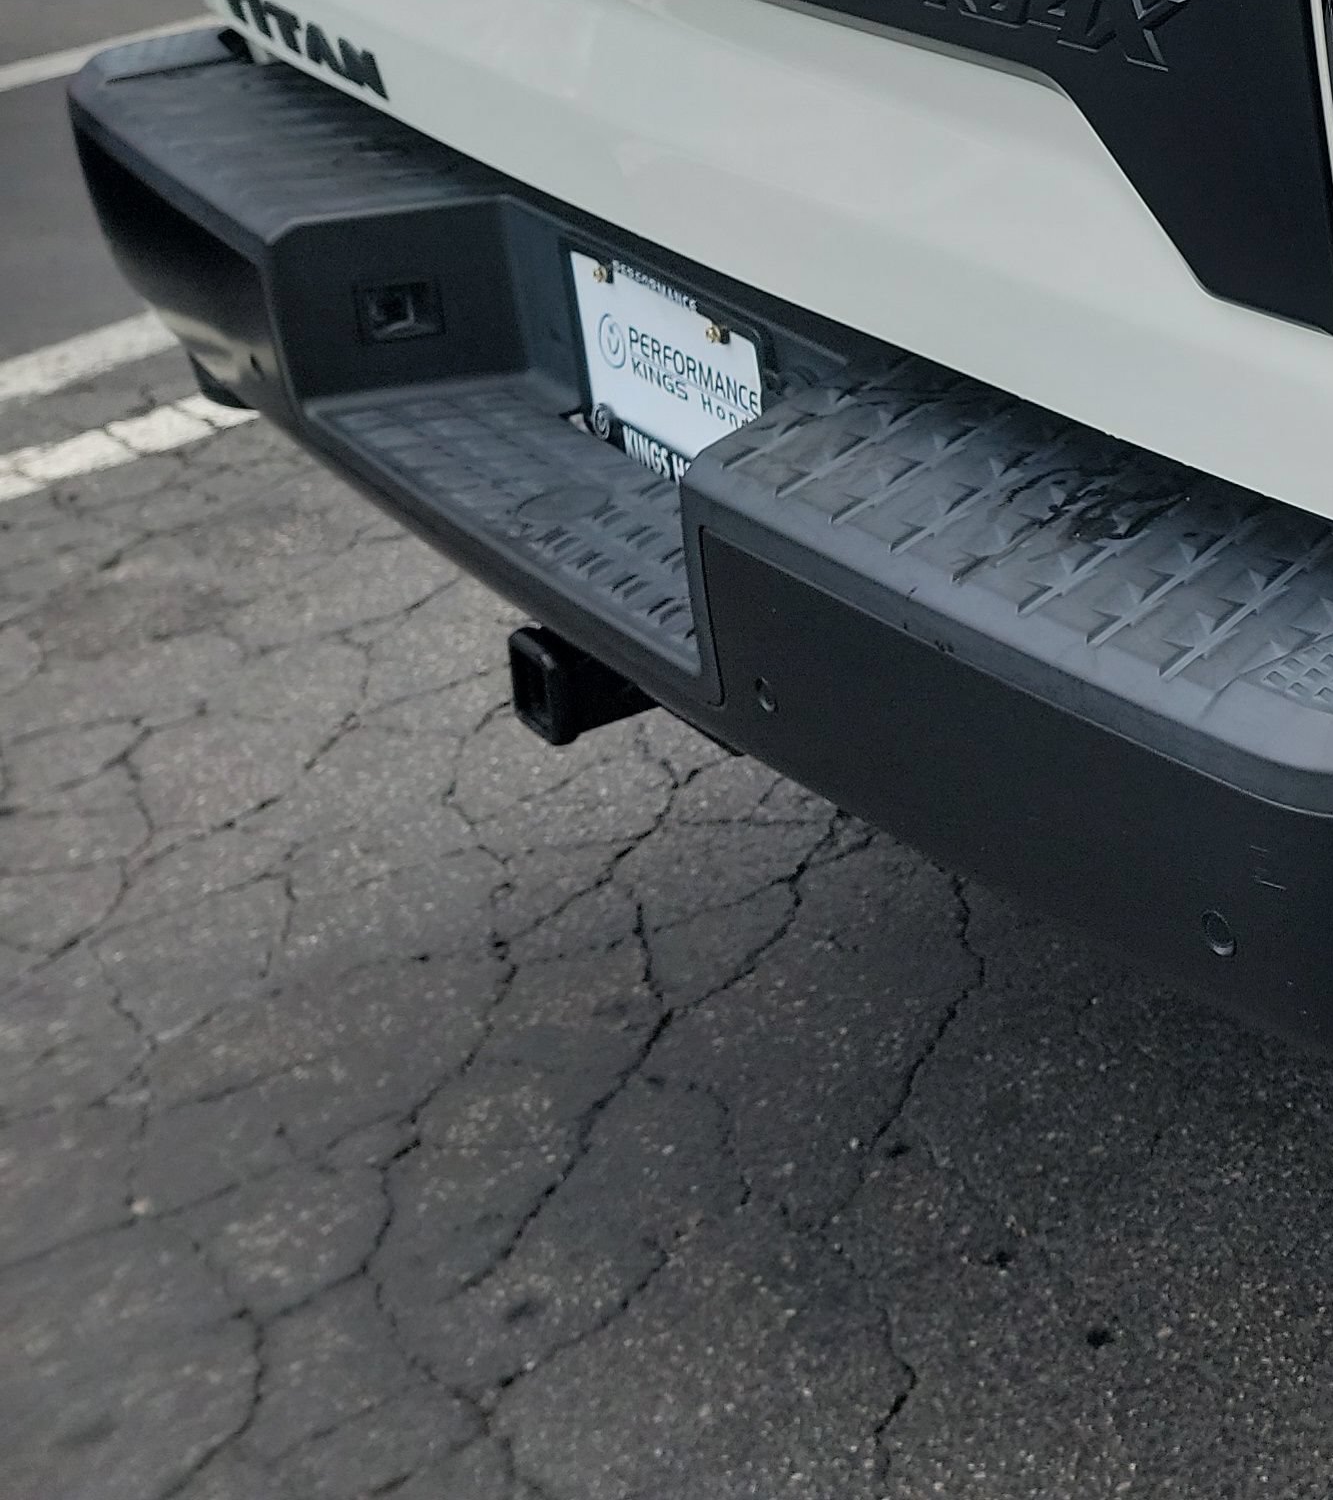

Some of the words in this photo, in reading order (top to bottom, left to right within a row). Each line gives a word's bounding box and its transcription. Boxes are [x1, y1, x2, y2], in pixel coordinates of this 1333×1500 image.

[629, 327, 760, 419] PERFORMANCE
[632, 357, 688, 401] KINGS
[622, 425, 670, 480] KINGS
